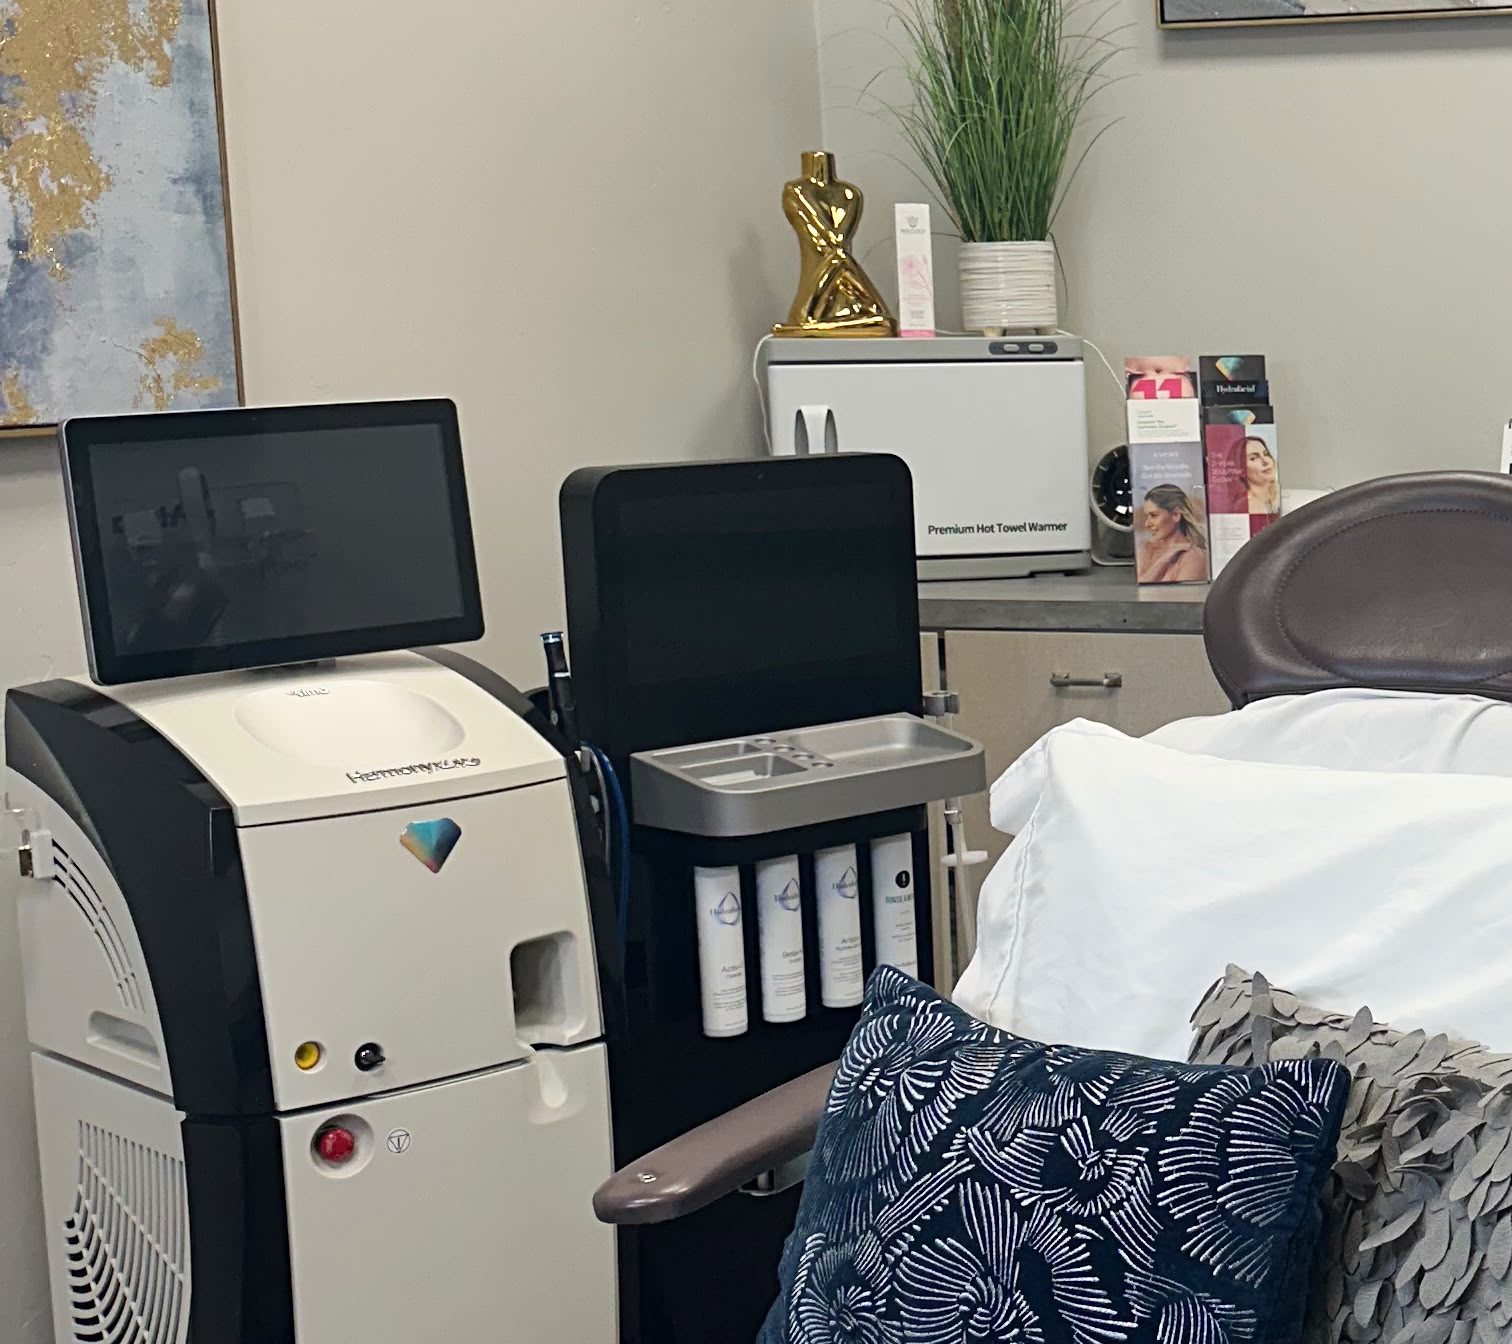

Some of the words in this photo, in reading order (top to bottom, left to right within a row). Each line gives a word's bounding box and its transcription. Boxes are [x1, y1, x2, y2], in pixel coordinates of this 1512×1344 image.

[927, 524, 975, 535] Premium
[976, 523, 995, 534] Hot
[996, 522, 1027, 533] Towel
[1027, 522, 1068, 532] Warmer
